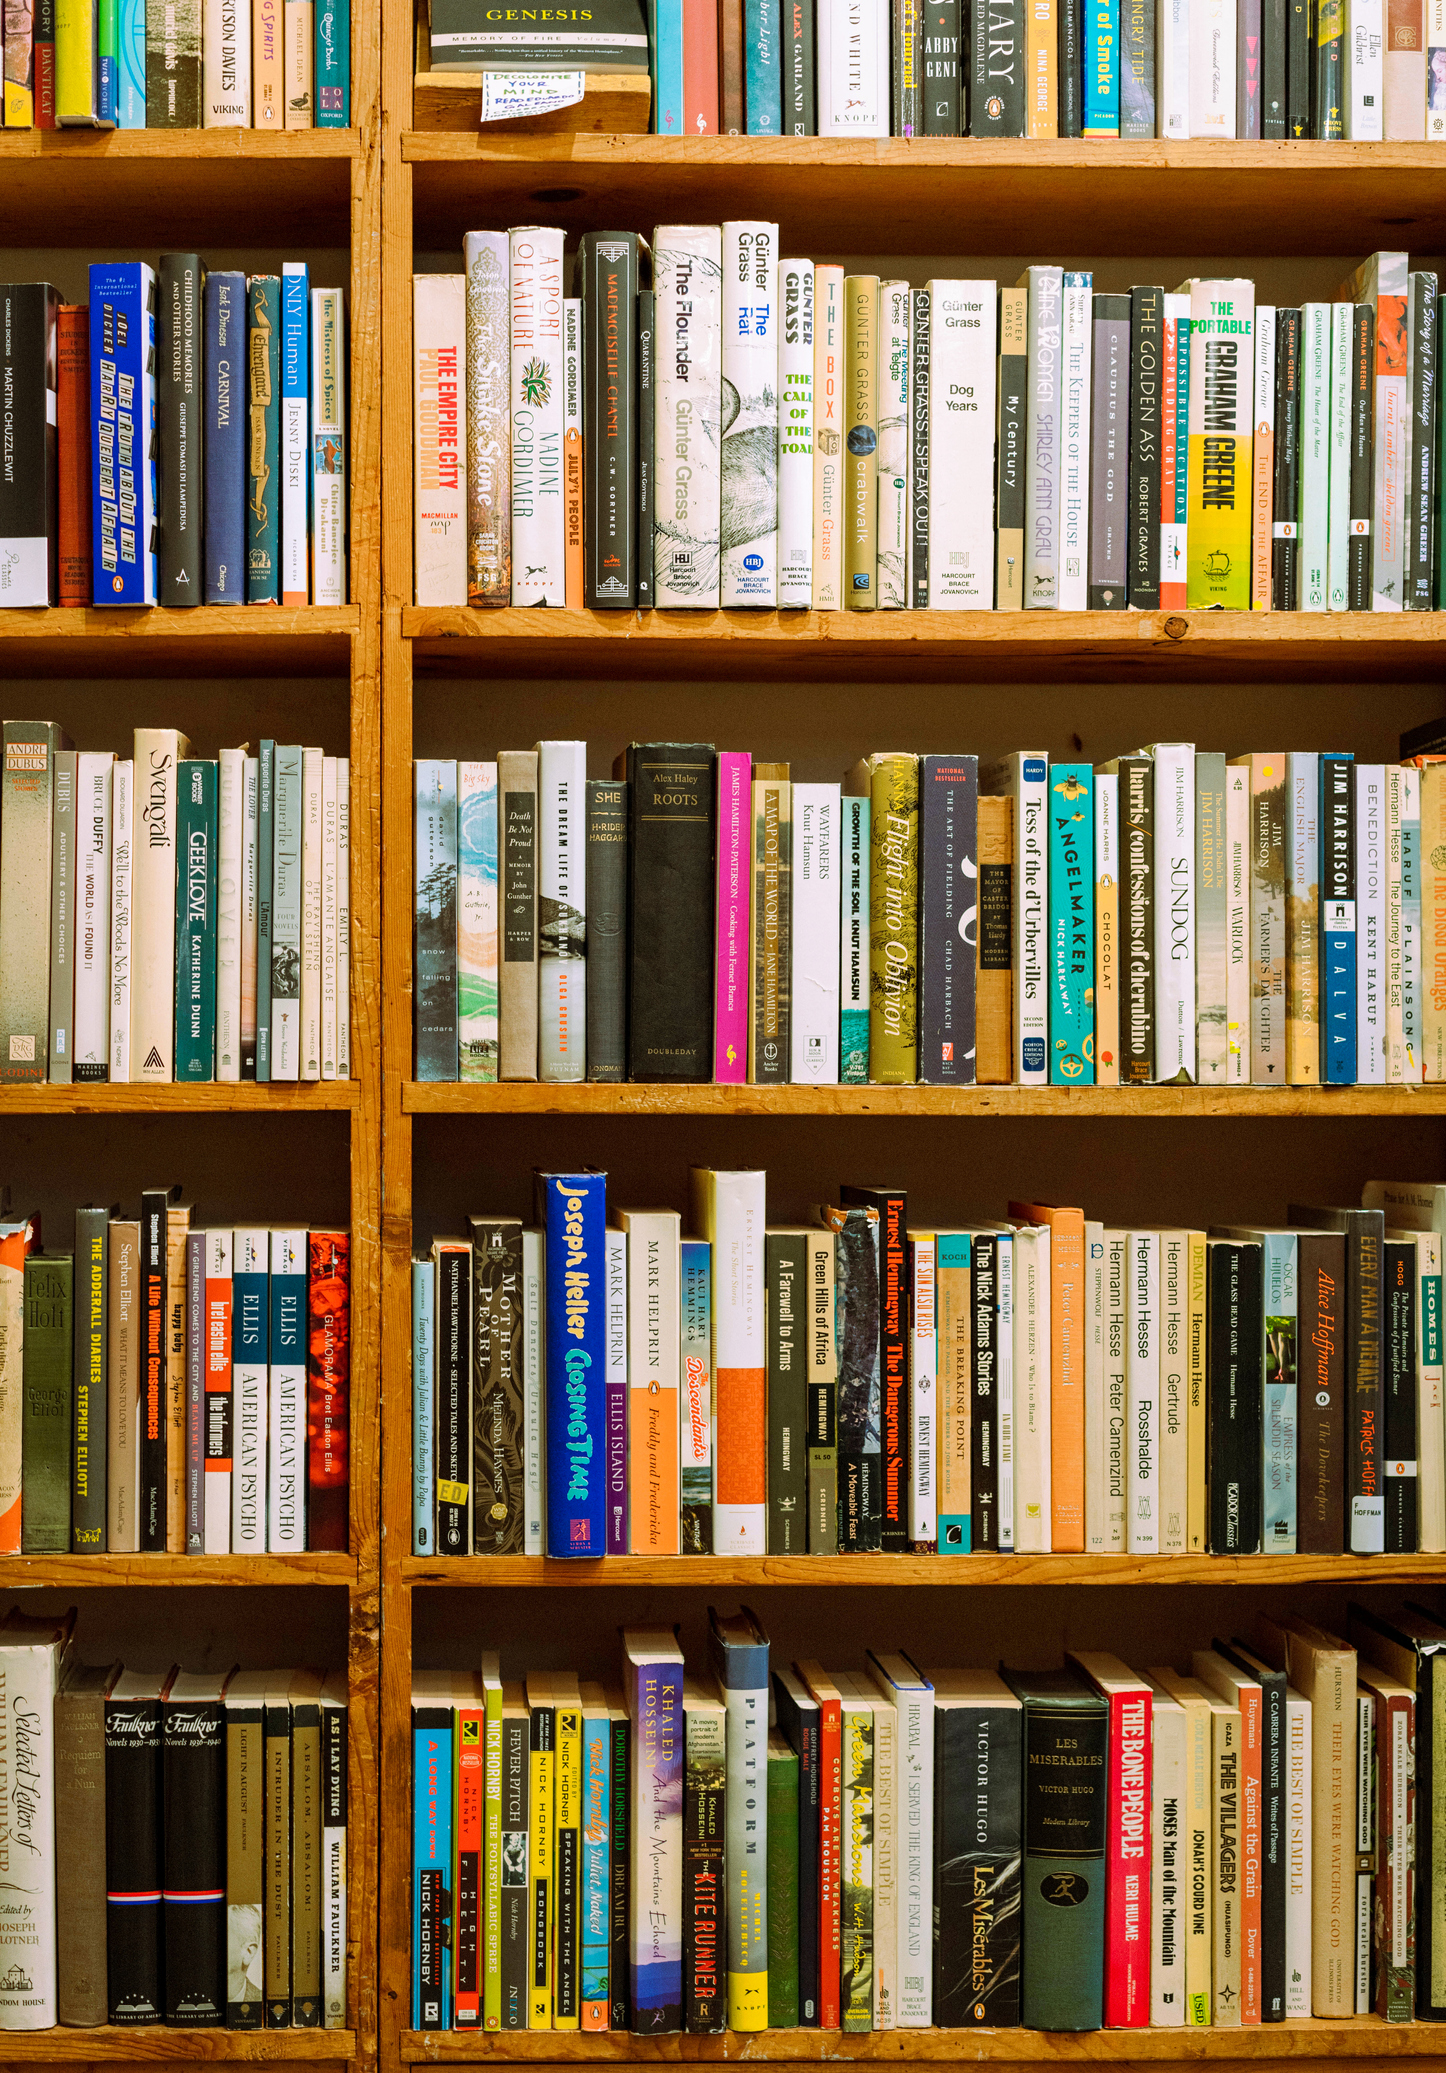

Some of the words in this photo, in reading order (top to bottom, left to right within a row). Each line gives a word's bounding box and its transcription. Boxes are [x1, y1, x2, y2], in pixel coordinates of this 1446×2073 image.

[486, 9, 593, 21] GENESIS
[792, 3, 802, 39] ALEX
[1098, 13, 1112, 29] of
[261, 15, 273, 61] SPIRITS
[925, 37, 958, 53] ABBY
[1356, 25, 1367, 65] Gilchrist
[1370, 35, 1380, 58] Ellen
[42, 48, 51, 116] DANTICAT
[222, 45, 235, 91] DAVIES
[794, 44, 802, 112] GARLAND
[927, 62, 956, 77] GENI
[1038, 50, 1048, 72] NINA
[1098, 35, 1113, 94] Smoke
[212, 105, 243, 115] VIKING
[1038, 76, 1048, 112] GEORGE
[834, 114, 878, 122] KNOPF
[219, 285, 230, 305] Isak
[676, 261, 691, 296] The
[103, 304, 114, 355] DICKER
[117, 313, 128, 346] JOEL
[219, 309, 229, 346] Dinesen
[608, 274, 618, 379] MADEMOISELLE
[857, 294, 869, 360] GÜNTER
[1190, 320, 1251, 334] PORTABLE
[1210, 301, 1234, 316] THE
[438, 346, 457, 377] THE
[641, 331, 651, 388] QUARANTINE
[676, 301, 691, 382] Flounder
[4, 367, 13, 409] MARTIN
[419, 348, 438, 393] PAUL
[1109, 335, 1117, 420] CLAUDIUS
[1204, 341, 1237, 431] GRAHAM
[1359, 360, 1367, 390] GREENE
[218, 361, 229, 428] CARNIVAL
[439, 382, 457, 448] EMPIRE
[608, 386, 618, 439] CHANEL
[857, 369, 869, 421] GRASS
[1005, 396, 1019, 414] My
[4, 412, 13, 482] CHUZZLEWIT
[420, 400, 439, 489] GOODMAN
[675, 399, 691, 461] Günter
[1036, 414, 1053, 473] SHIRLEY
[1108, 429, 1116, 459] THE
[439, 452, 458, 489] CITY
[1005, 422, 1018, 487] Century
[1203, 438, 1236, 510] GREENE
[676, 466, 691, 520] Grass
[857, 462, 869, 543] crabwalk
[1036, 478, 1052, 510] ANN
[1035, 516, 1052, 557] GRAU
[217, 565, 226, 591] Chicago
[57, 772, 71, 812] DUBUS
[143, 749, 172, 848] Svengali
[559, 782, 567, 802] THE
[653, 794, 698, 806] ROOTS
[1334, 764, 1347, 794] JIM
[559, 809, 567, 847] DREAM
[803, 805, 814, 831] Knut
[190, 832, 207, 876] GEEK
[803, 835, 813, 879] Hamsun
[819, 805, 829, 879] WAYFARERS
[1334, 805, 1347, 896] HARRISON
[1367, 785, 1377, 899] BENEDICTION
[558, 854, 567, 878] LIFE
[190, 879, 207, 922] LOVE
[558, 885, 567, 898] OF
[1171, 858, 1188, 960] SUNDOG
[558, 905, 568, 964] SUKHANOV
[1103, 912, 1111, 990] CHOCOLAT
[1367, 916, 1376, 960] KENT
[191, 935, 202, 999] KATHERINE
[558, 975, 567, 1000] OLGA
[1367, 968, 1376, 1025] HARUF
[191, 1005, 200, 1038] DUNN
[558, 1007, 567, 1052] GRUSHIN
[1318, 1268, 1334, 1308] Alice
[280, 1296, 296, 1344] ELLIS
[324, 1315, 333, 1389] GLAMORAMA
[1312, 1312, 1334, 1386] Hoffman
[78, 1385, 88, 1442] STEPHEN
[280, 1374, 295, 1467] AMERICAN
[494, 1393, 503, 1443] MELINDA
[611, 1394, 623, 1432] ELLIS
[1167, 1373, 1180, 1434] Gertrude
[647, 1408, 660, 1451] Freddy
[957, 1420, 965, 1460] POINT
[1139, 1400, 1151, 1479] Rosshalde
[77, 1446, 88, 1496] ELLIOTT
[493, 1448, 504, 1493] HAYNES
[611, 1437, 623, 1492] ISLAND
[649, 1454, 659, 1476] and
[149, 1487, 157, 1535] MacAdam/Cage
[279, 1474, 294, 1540] PSYCHO
[649, 1481, 660, 1545] Fredericka
[331, 1716, 339, 1733] AS
[331, 1747, 339, 1772] LAY
[509, 1729, 520, 1775] FEVER
[977, 1721, 988, 1786] VICTOR
[331, 1776, 339, 1816] DYING
[509, 1778, 521, 1822] PITCH
[1244, 1776, 1258, 1829] Against
[977, 1795, 988, 1843] HUGO
[1192, 1830, 1204, 1871] JONAH'S
[1246, 1834, 1258, 1854] the
[331, 1842, 339, 1899] WILLIAM
[1125, 1875, 1138, 1900] KERI
[1193, 1874, 1205, 1910] GOURD
[1245, 1858, 1258, 1897] Grain
[331, 1904, 339, 1973] FAULKNER
[1125, 1904, 1138, 1941] HULME
[1193, 1912, 1204, 1935] VINE
[1247, 1929, 1257, 1958] Dover
[509, 1986, 518, 2024] INDIGO
[1194, 1995, 1204, 2023] USED
